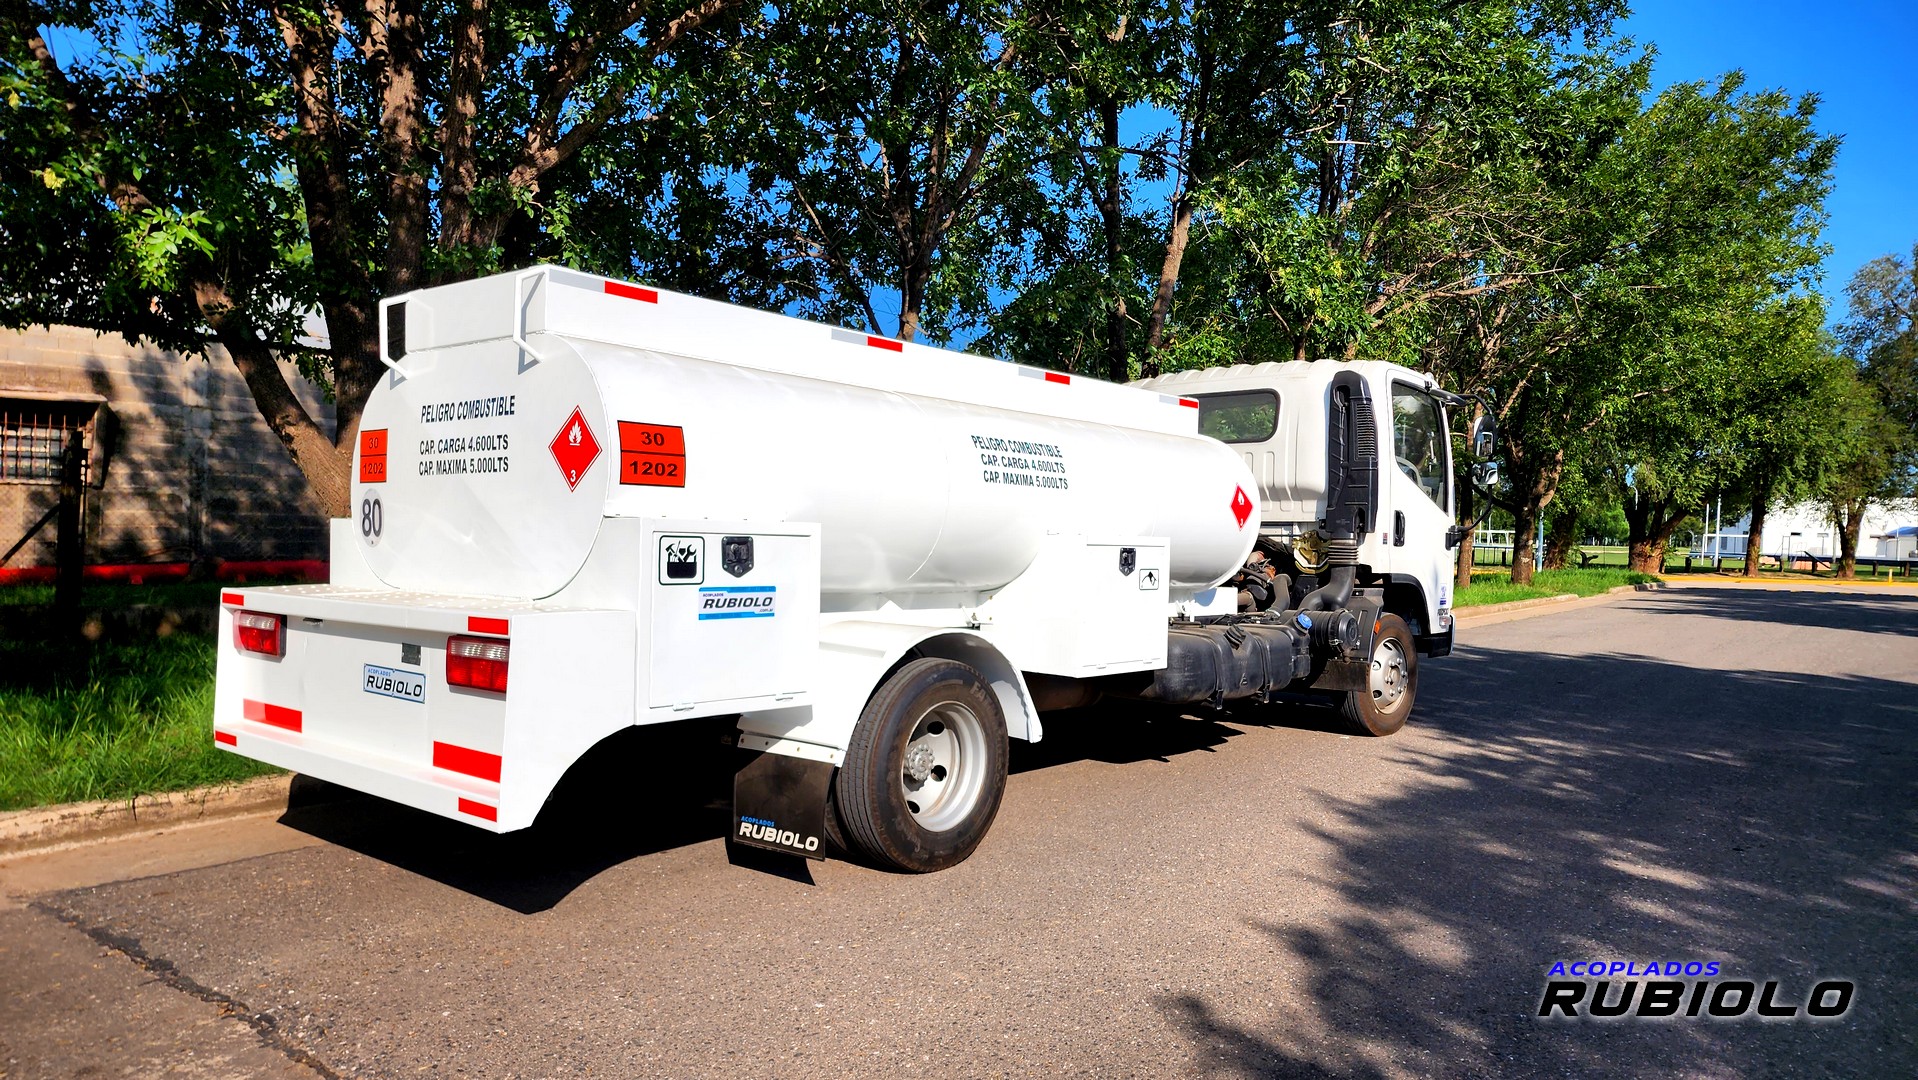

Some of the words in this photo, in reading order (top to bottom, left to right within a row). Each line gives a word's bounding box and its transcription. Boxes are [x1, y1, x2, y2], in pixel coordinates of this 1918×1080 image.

[421, 402, 455, 423] PELIGRO
[457, 395, 515, 420] COMBUSTIBLE
[368, 437, 379, 449] 30
[420, 440, 435, 455] CAP.
[438, 437, 466, 454] CARGA
[468, 434, 509, 452] 4.600LTS
[641, 431, 665, 447] 30
[971, 434, 1008, 452] PELIGRO
[1008, 439, 1063, 458] COMBUSTIBLE
[363, 462, 384, 475] 1202
[419, 460, 434, 476] CAP.
[436, 458, 467, 475] MAXIMA
[470, 456, 509, 474] 5.000LTS
[630, 461, 678, 477] 1202
[981, 453, 1000, 467] CAP.
[1001, 456, 1030, 471] CARGA
[1031, 459, 1066, 474] 4.600LTS
[570, 469, 577, 483] 3
[983, 470, 1001, 484] CAP.
[1002, 471, 1034, 487] MAXIMA
[1035, 475, 1069, 490] 5.000LTS
[362, 498, 383, 538] 80
[703, 597, 773, 609] RUBIOLO
[367, 668, 391, 677] ACOPLADOS
[366, 675, 423, 697] RUBIOLO
[740, 815, 775, 828] ACOPLADOS
[739, 822, 819, 851] RUBIOLO
